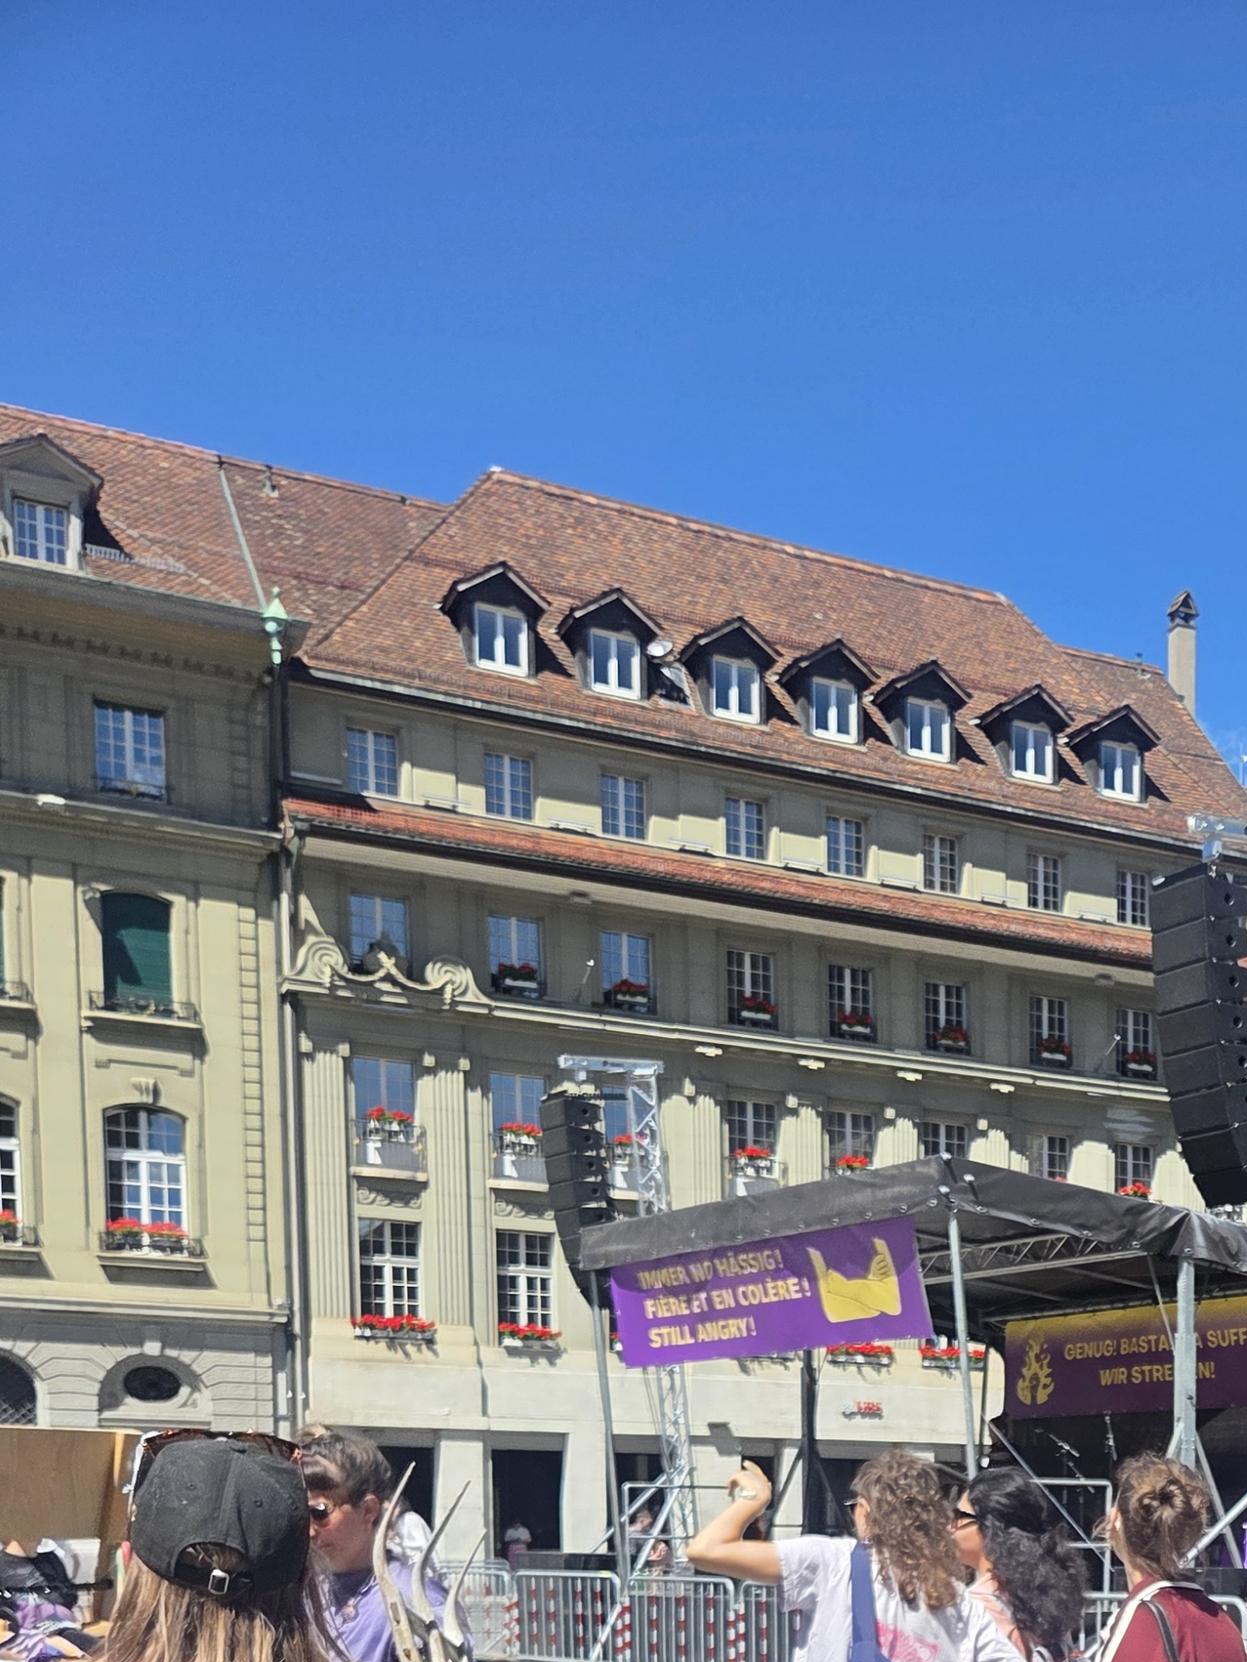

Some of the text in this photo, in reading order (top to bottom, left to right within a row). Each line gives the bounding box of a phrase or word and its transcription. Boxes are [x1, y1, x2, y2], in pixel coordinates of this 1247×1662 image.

[638, 1265, 690, 1290] IMMER
[710, 1288, 735, 1310] EN
[648, 1325, 695, 1348] STILL
[1064, 1340, 1117, 1361] GENUG!
[1120, 1334, 1172, 1355] BASTA
[1099, 1361, 1215, 1386] WIR STREN!
